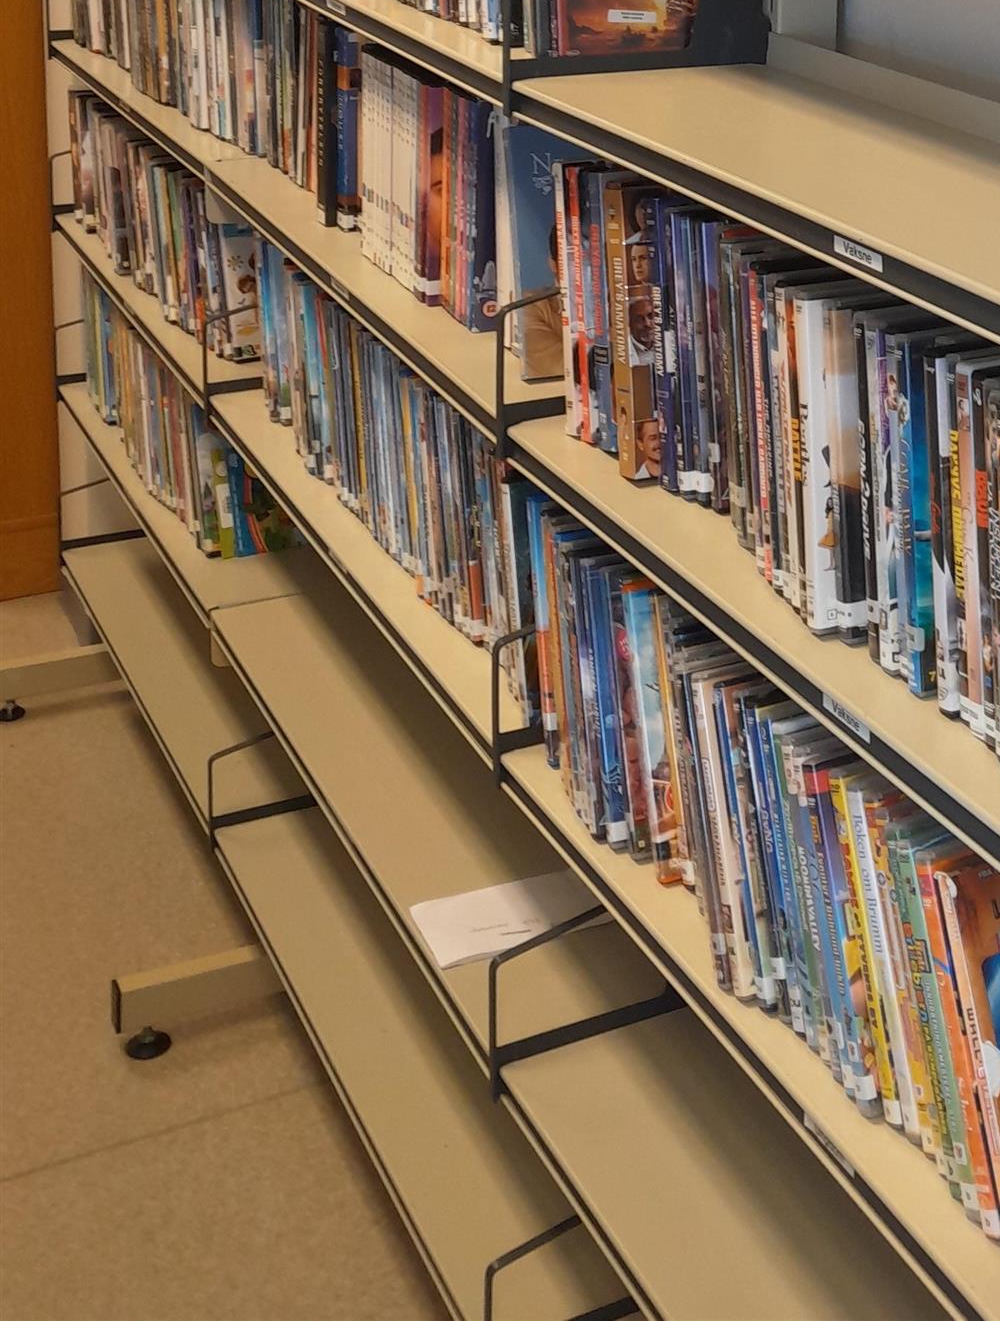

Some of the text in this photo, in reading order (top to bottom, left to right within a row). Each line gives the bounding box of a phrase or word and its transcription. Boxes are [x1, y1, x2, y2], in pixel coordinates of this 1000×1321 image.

[842, 240, 872, 264] Vaksne
[613, 257, 625, 364] GREY'S ANATOMY
[652, 286, 665, 378] GREY'S ANATOMY
[792, 417, 802, 482] BATTLE
[854, 814, 882, 954] Boken om Brumm
